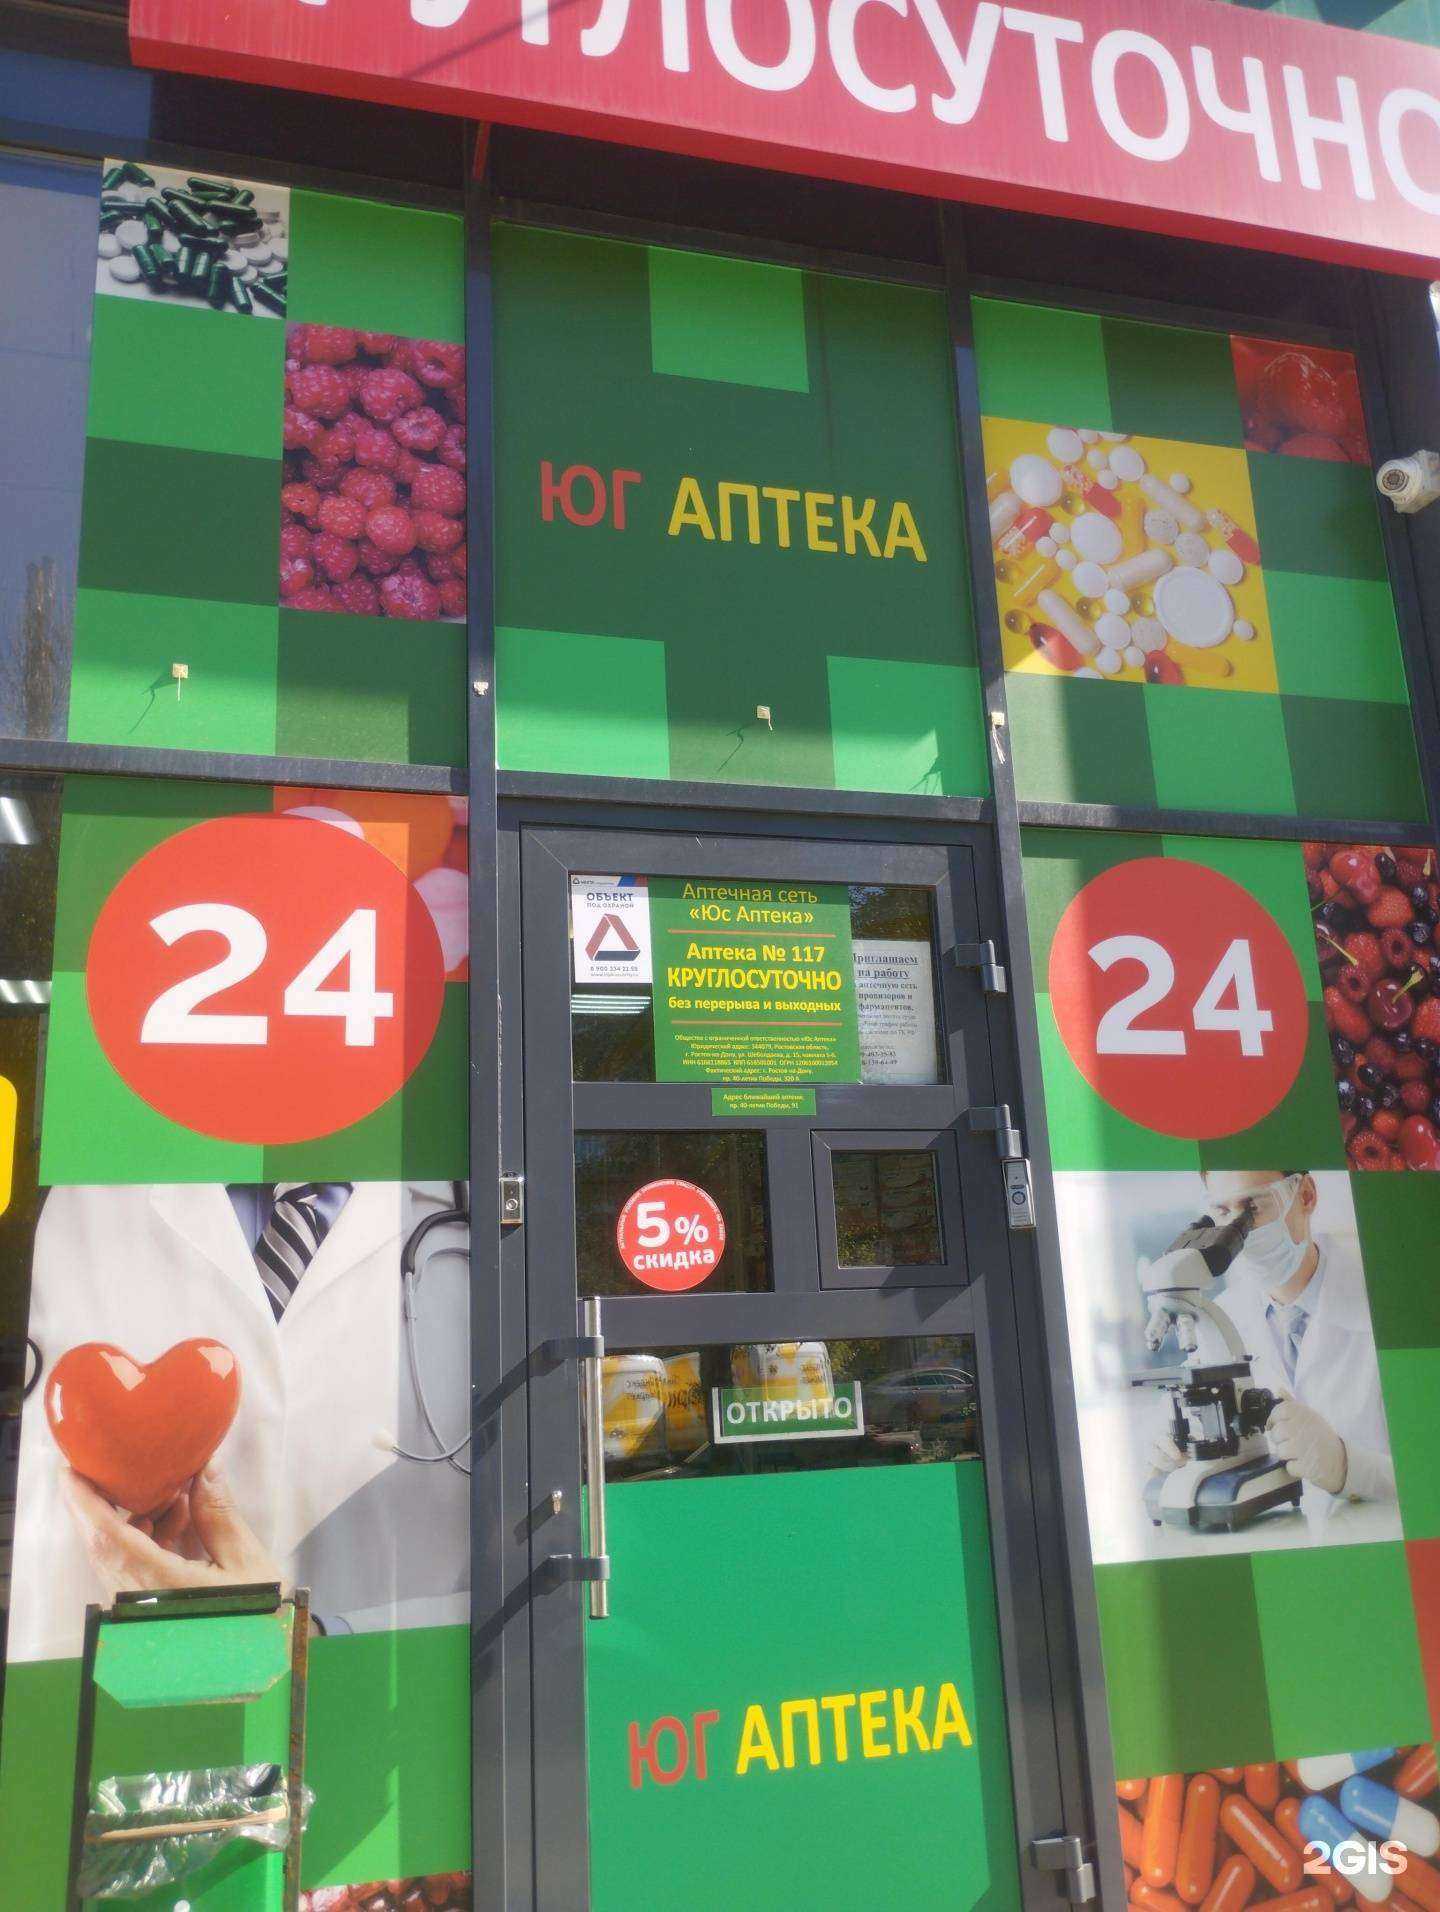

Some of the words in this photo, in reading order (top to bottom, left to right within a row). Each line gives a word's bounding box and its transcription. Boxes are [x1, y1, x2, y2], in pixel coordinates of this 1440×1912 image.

[305, 0, 1440, 216] ЛОСУТОЧНО
[539, 460, 641, 530] ЮГ
[667, 476, 927, 563] АПТЕКА
[586, 892, 634, 902] ОБЪЕКТ
[682, 882, 772, 903] Аптечная
[778, 889, 818, 904] сеть
[689, 904, 731, 922] «Юс
[736, 905, 814, 924] Аптека»
[686, 942, 757, 961] Аптека
[762, 944, 786, 962] №
[792, 946, 825, 962] 117
[140, 902, 393, 1046] 24
[667, 967, 842, 991] КРУГЛОСУТОЧНО
[858, 969, 871, 977] на
[873, 967, 910, 980] работу
[668, 996, 691, 1009] без
[695, 999, 760, 1012] перерыва
[763, 1000, 771, 1010] и
[775, 1000, 841, 1013] выходных
[1088, 935, 1274, 1057] 24
[633, 1248, 715, 1270] скидка
[726, 1397, 851, 1425] ОТКРЫТО
[628, 1709, 720, 1789] ЮГ
[736, 1682, 973, 1776] АПТЕКА
